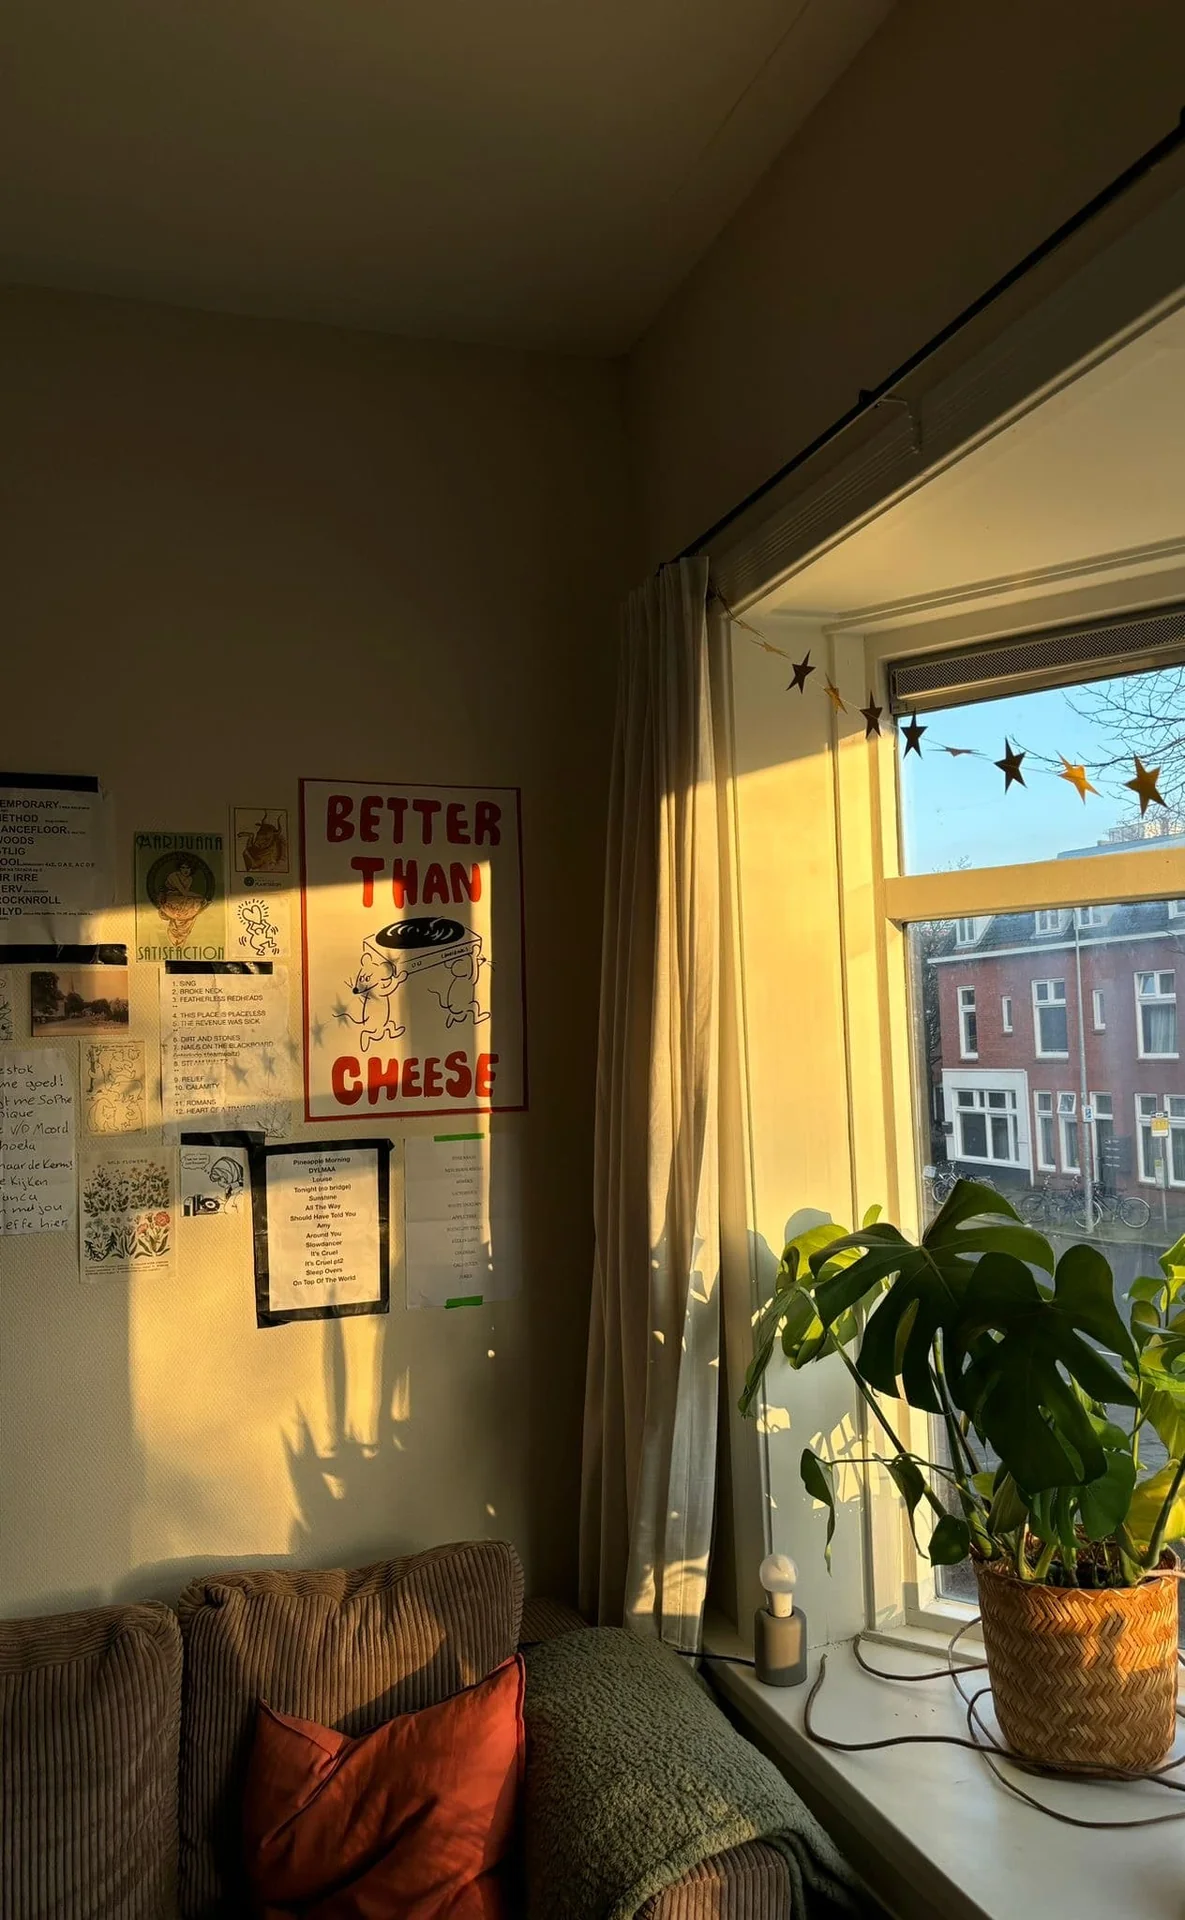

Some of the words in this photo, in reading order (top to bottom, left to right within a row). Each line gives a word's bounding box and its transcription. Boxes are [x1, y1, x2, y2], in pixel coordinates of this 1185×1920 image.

[0, 814, 38, 822] ETHOD
[326, 794, 501, 846] BETTER
[136, 834, 223, 850] MARIJUANA
[350, 856, 482, 909] THAN
[0, 896, 61, 904] OCKNROLL
[138, 946, 224, 960] SATISFACTION
[332, 1051, 500, 1106] CHEESE
[306, 1240, 342, 1248] Slowdancer
